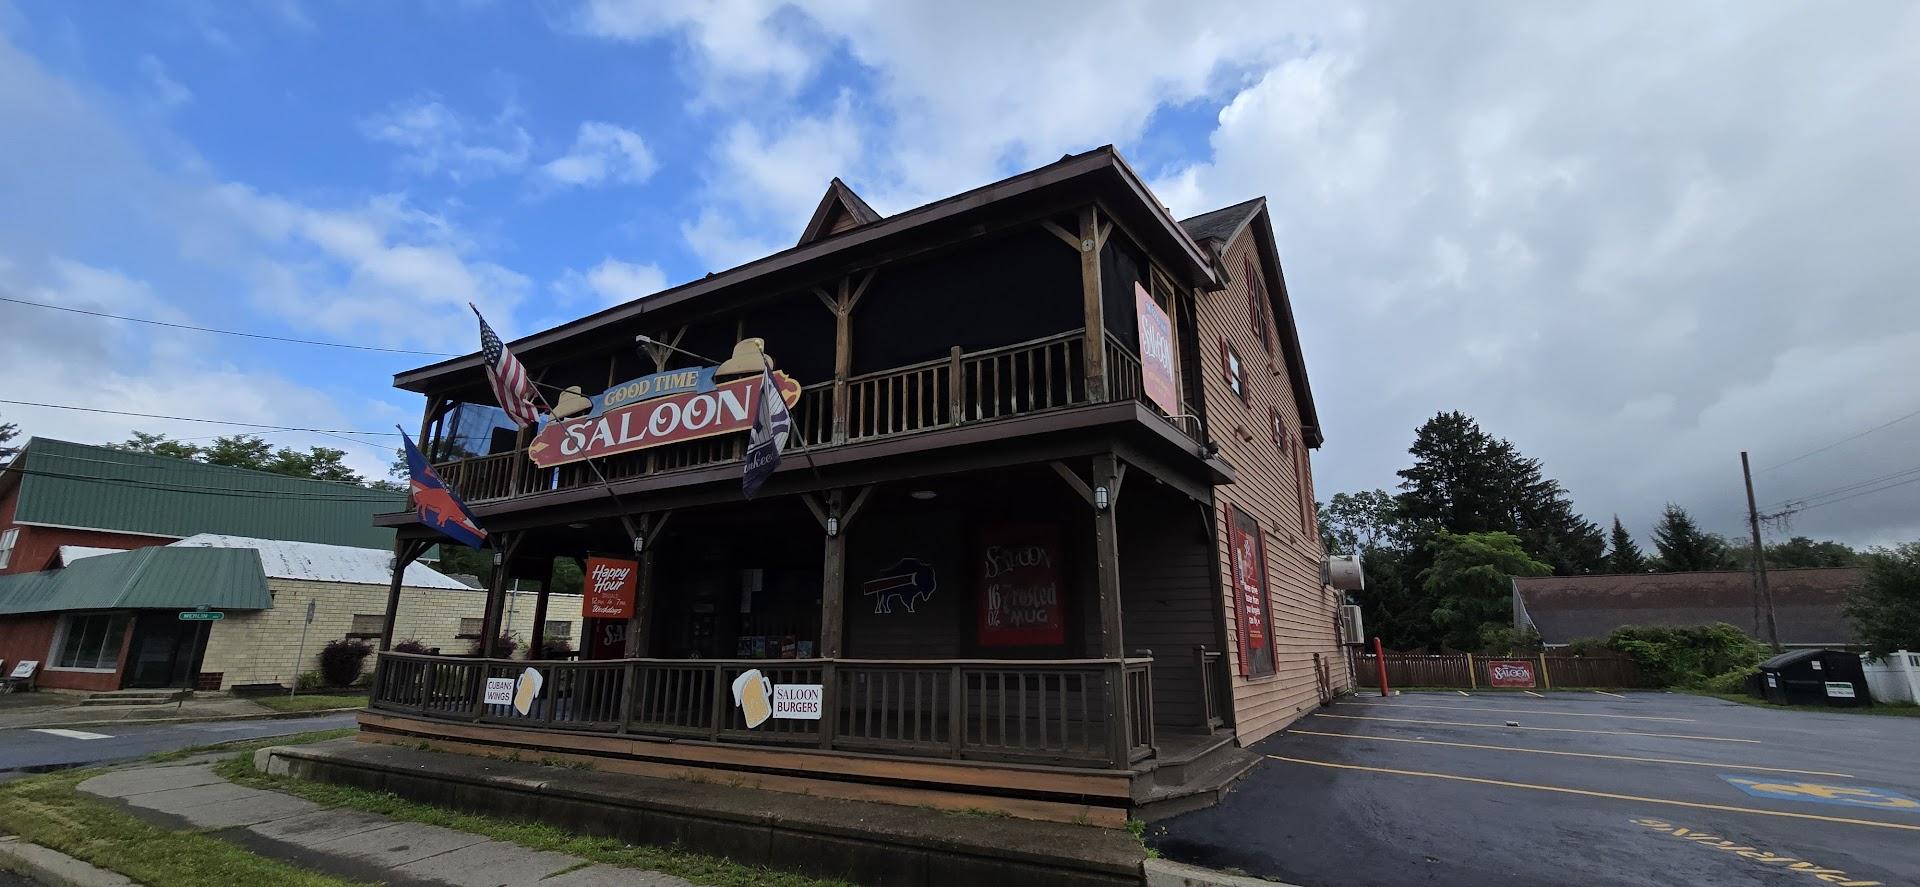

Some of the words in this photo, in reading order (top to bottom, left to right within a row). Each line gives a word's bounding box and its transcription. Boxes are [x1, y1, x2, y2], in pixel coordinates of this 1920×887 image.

[604, 378, 649, 407] GOOD
[654, 369, 699, 393] TIME
[560, 384, 752, 456] SALOON
[591, 564, 631, 581] Happy
[594, 577, 625, 593] Hour
[987, 583, 1001, 610] 16
[592, 604, 622, 616] Weekdays
[1010, 609, 1048, 626] MUG
[1494, 666, 1531, 680] SALOON
[488, 681, 512, 690] CUBANS
[487, 692, 510, 701] WINGS
[777, 688, 819, 701] SALOON
[777, 701, 818, 713] BURGERS
[1629, 818, 1882, 887] PARKING
